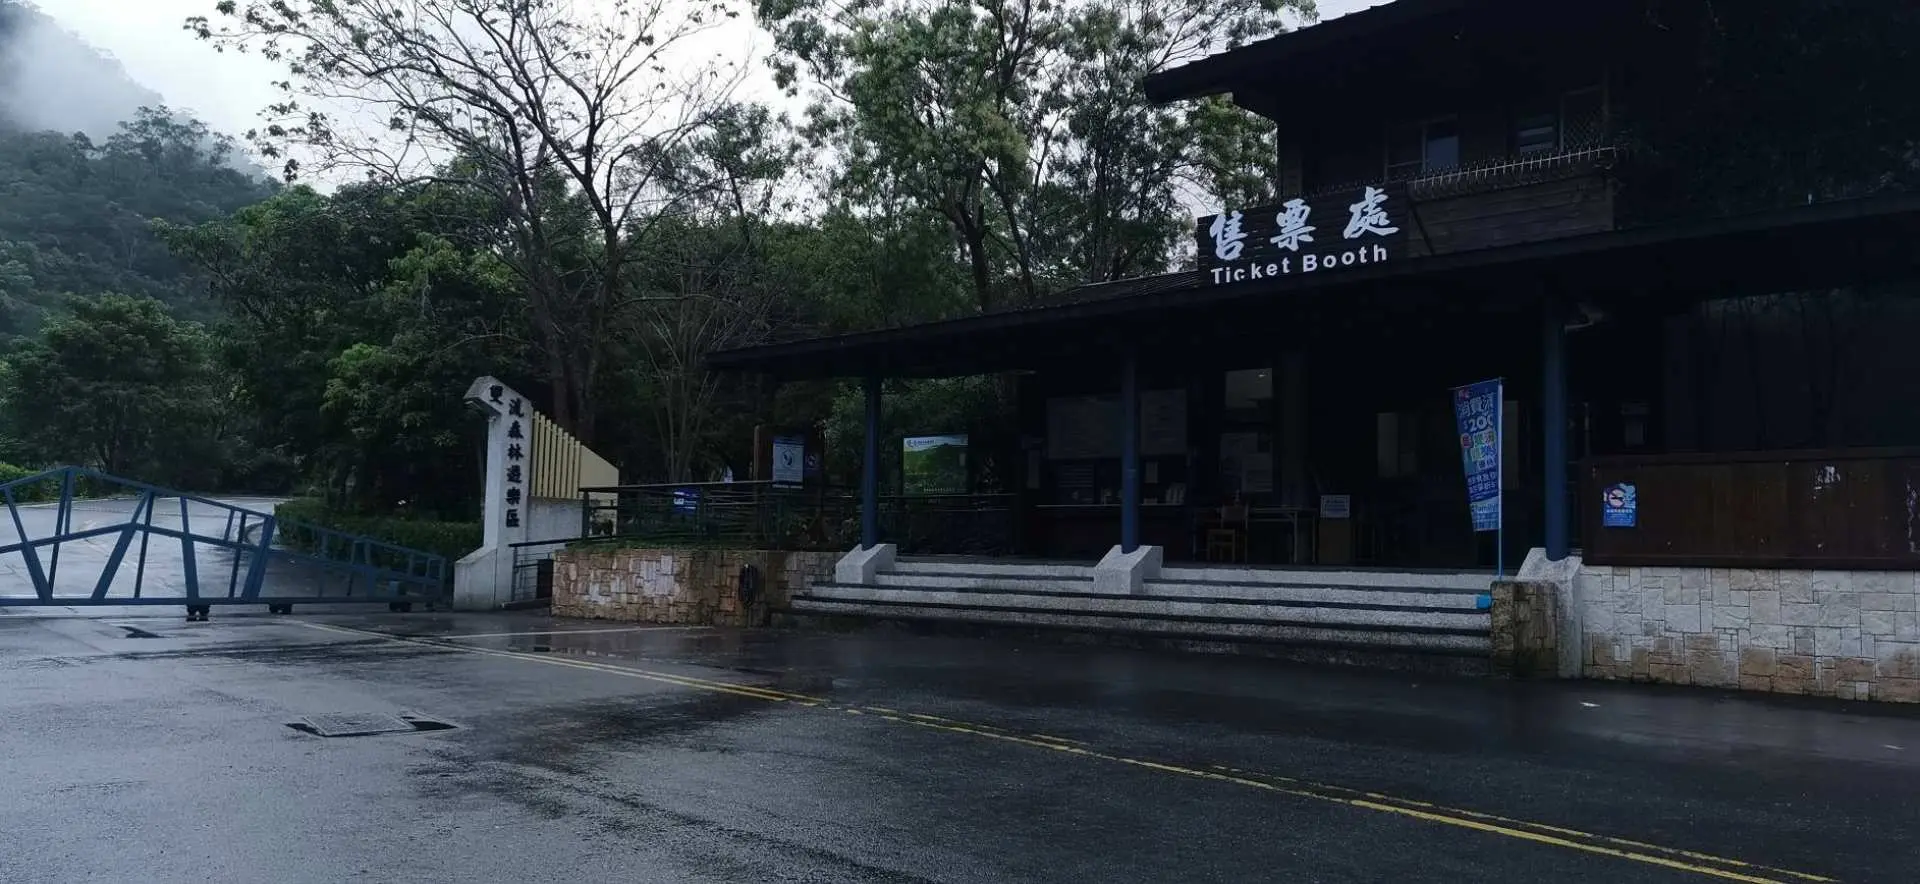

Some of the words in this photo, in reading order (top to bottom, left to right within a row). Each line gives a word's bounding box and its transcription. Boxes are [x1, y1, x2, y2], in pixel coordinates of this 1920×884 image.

[1209, 186, 1400, 260] 售票處
[1211, 256, 1291, 284] Ticket
[1303, 244, 1388, 272] Booth
